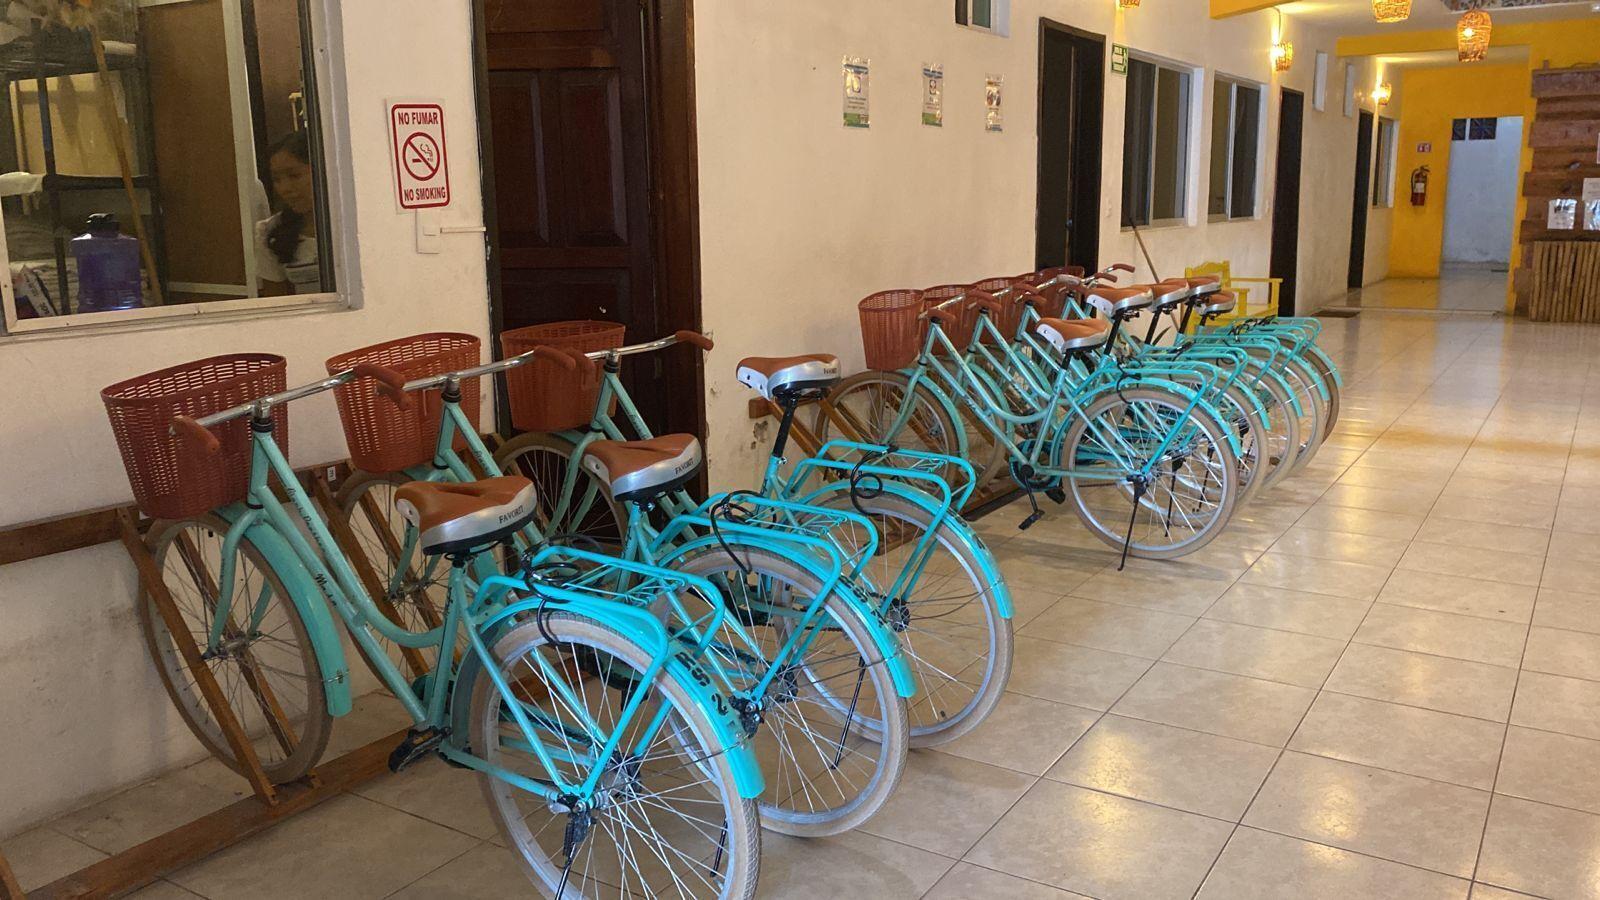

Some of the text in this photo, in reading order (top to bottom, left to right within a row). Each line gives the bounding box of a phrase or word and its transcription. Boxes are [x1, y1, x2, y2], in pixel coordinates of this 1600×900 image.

[398, 112, 438, 125] NO FUMAR
[404, 187, 446, 201] NO SMOKING
